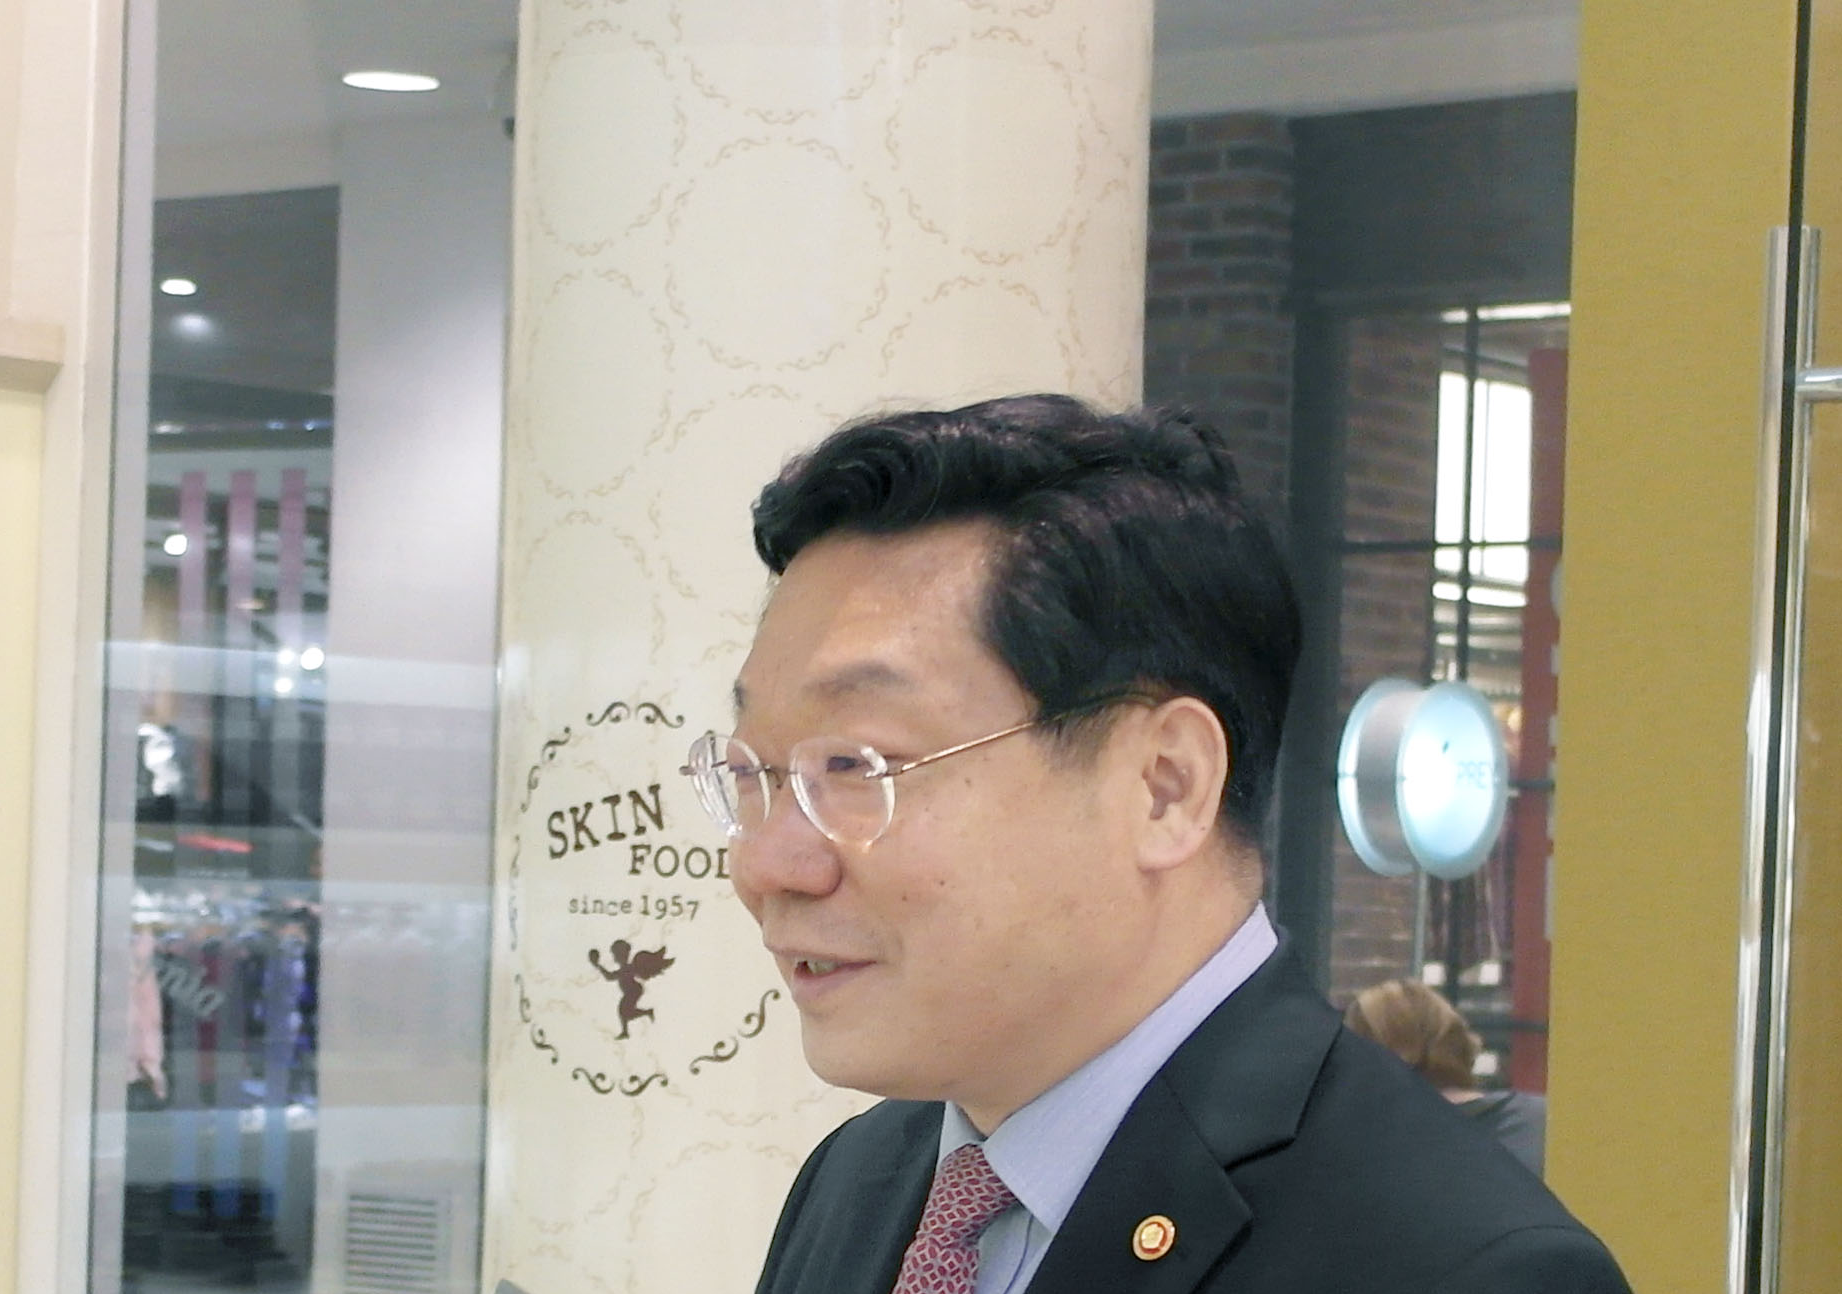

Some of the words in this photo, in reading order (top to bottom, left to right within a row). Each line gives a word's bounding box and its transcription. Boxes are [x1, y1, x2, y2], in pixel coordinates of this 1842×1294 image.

[547, 783, 665, 860] SKIN
[568, 895, 632, 916] since
[639, 894, 700, 922] 1957
